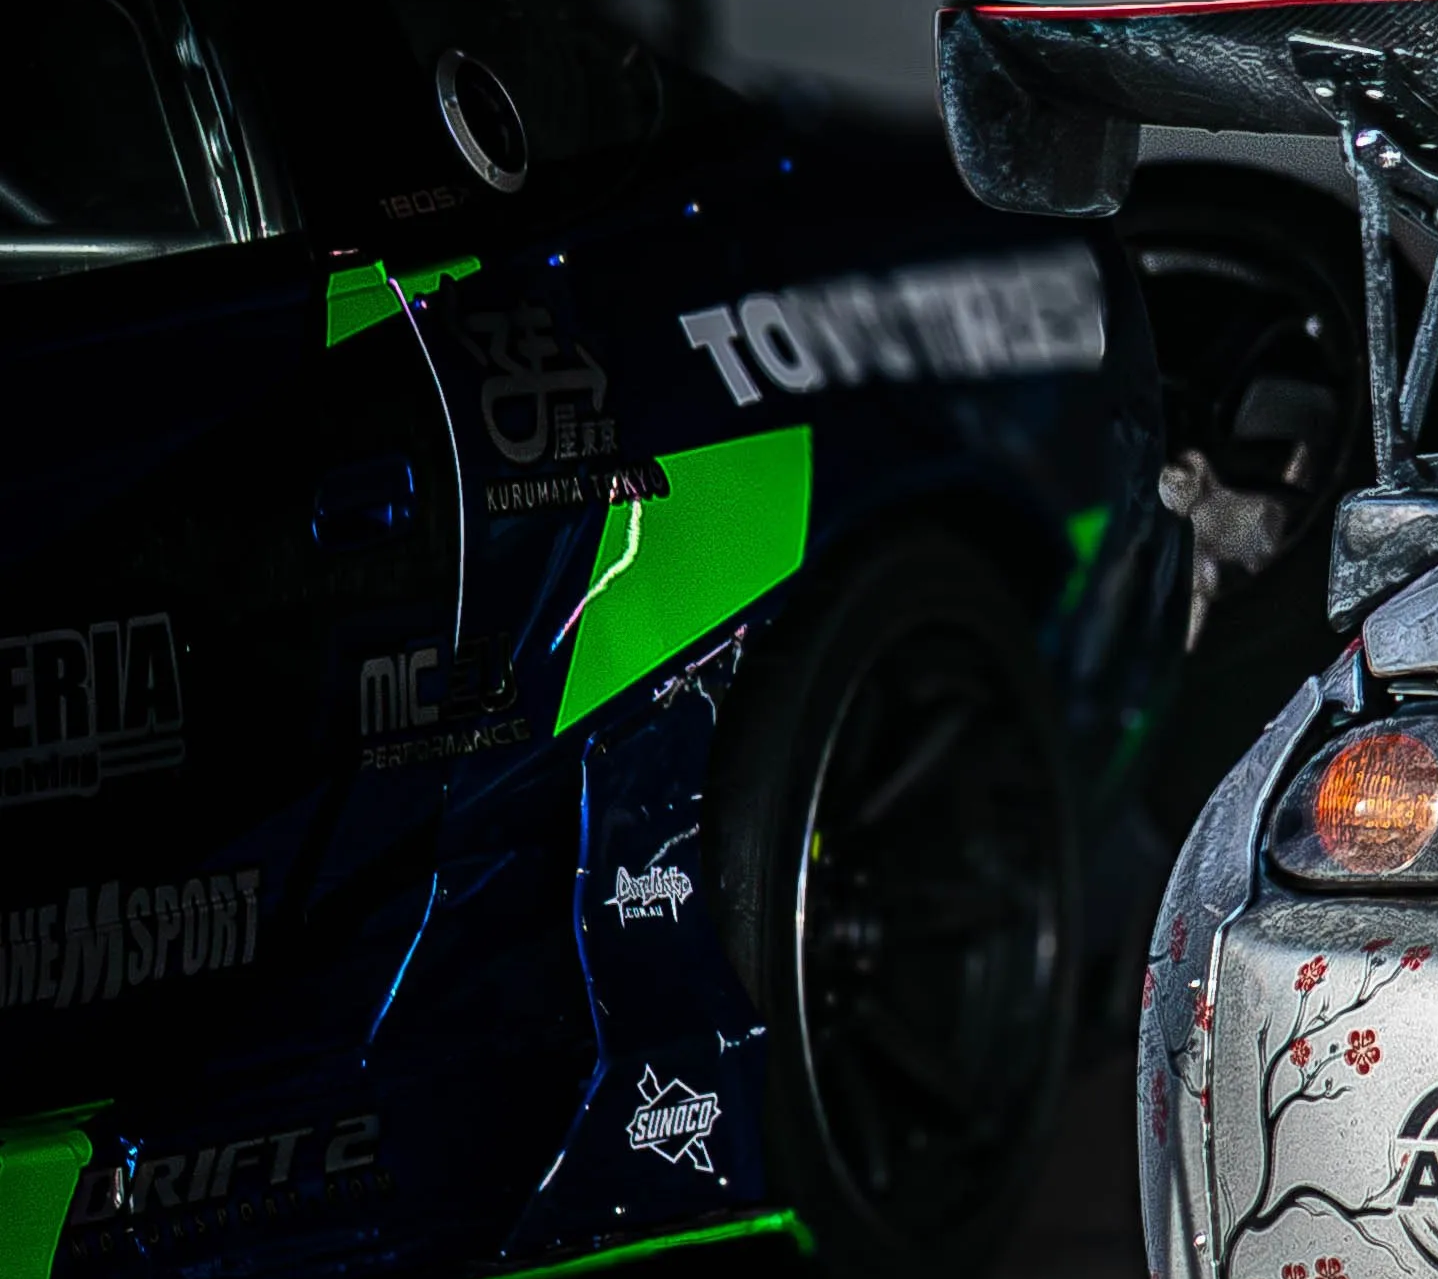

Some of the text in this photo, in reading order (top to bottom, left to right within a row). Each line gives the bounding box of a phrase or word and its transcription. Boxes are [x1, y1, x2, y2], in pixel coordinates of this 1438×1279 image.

[486, 464, 664, 513] KURUMAYA TOKYO
[633, 1099, 713, 1142] SUNOCO
[70, 1112, 382, 1226] DRIFT 2
